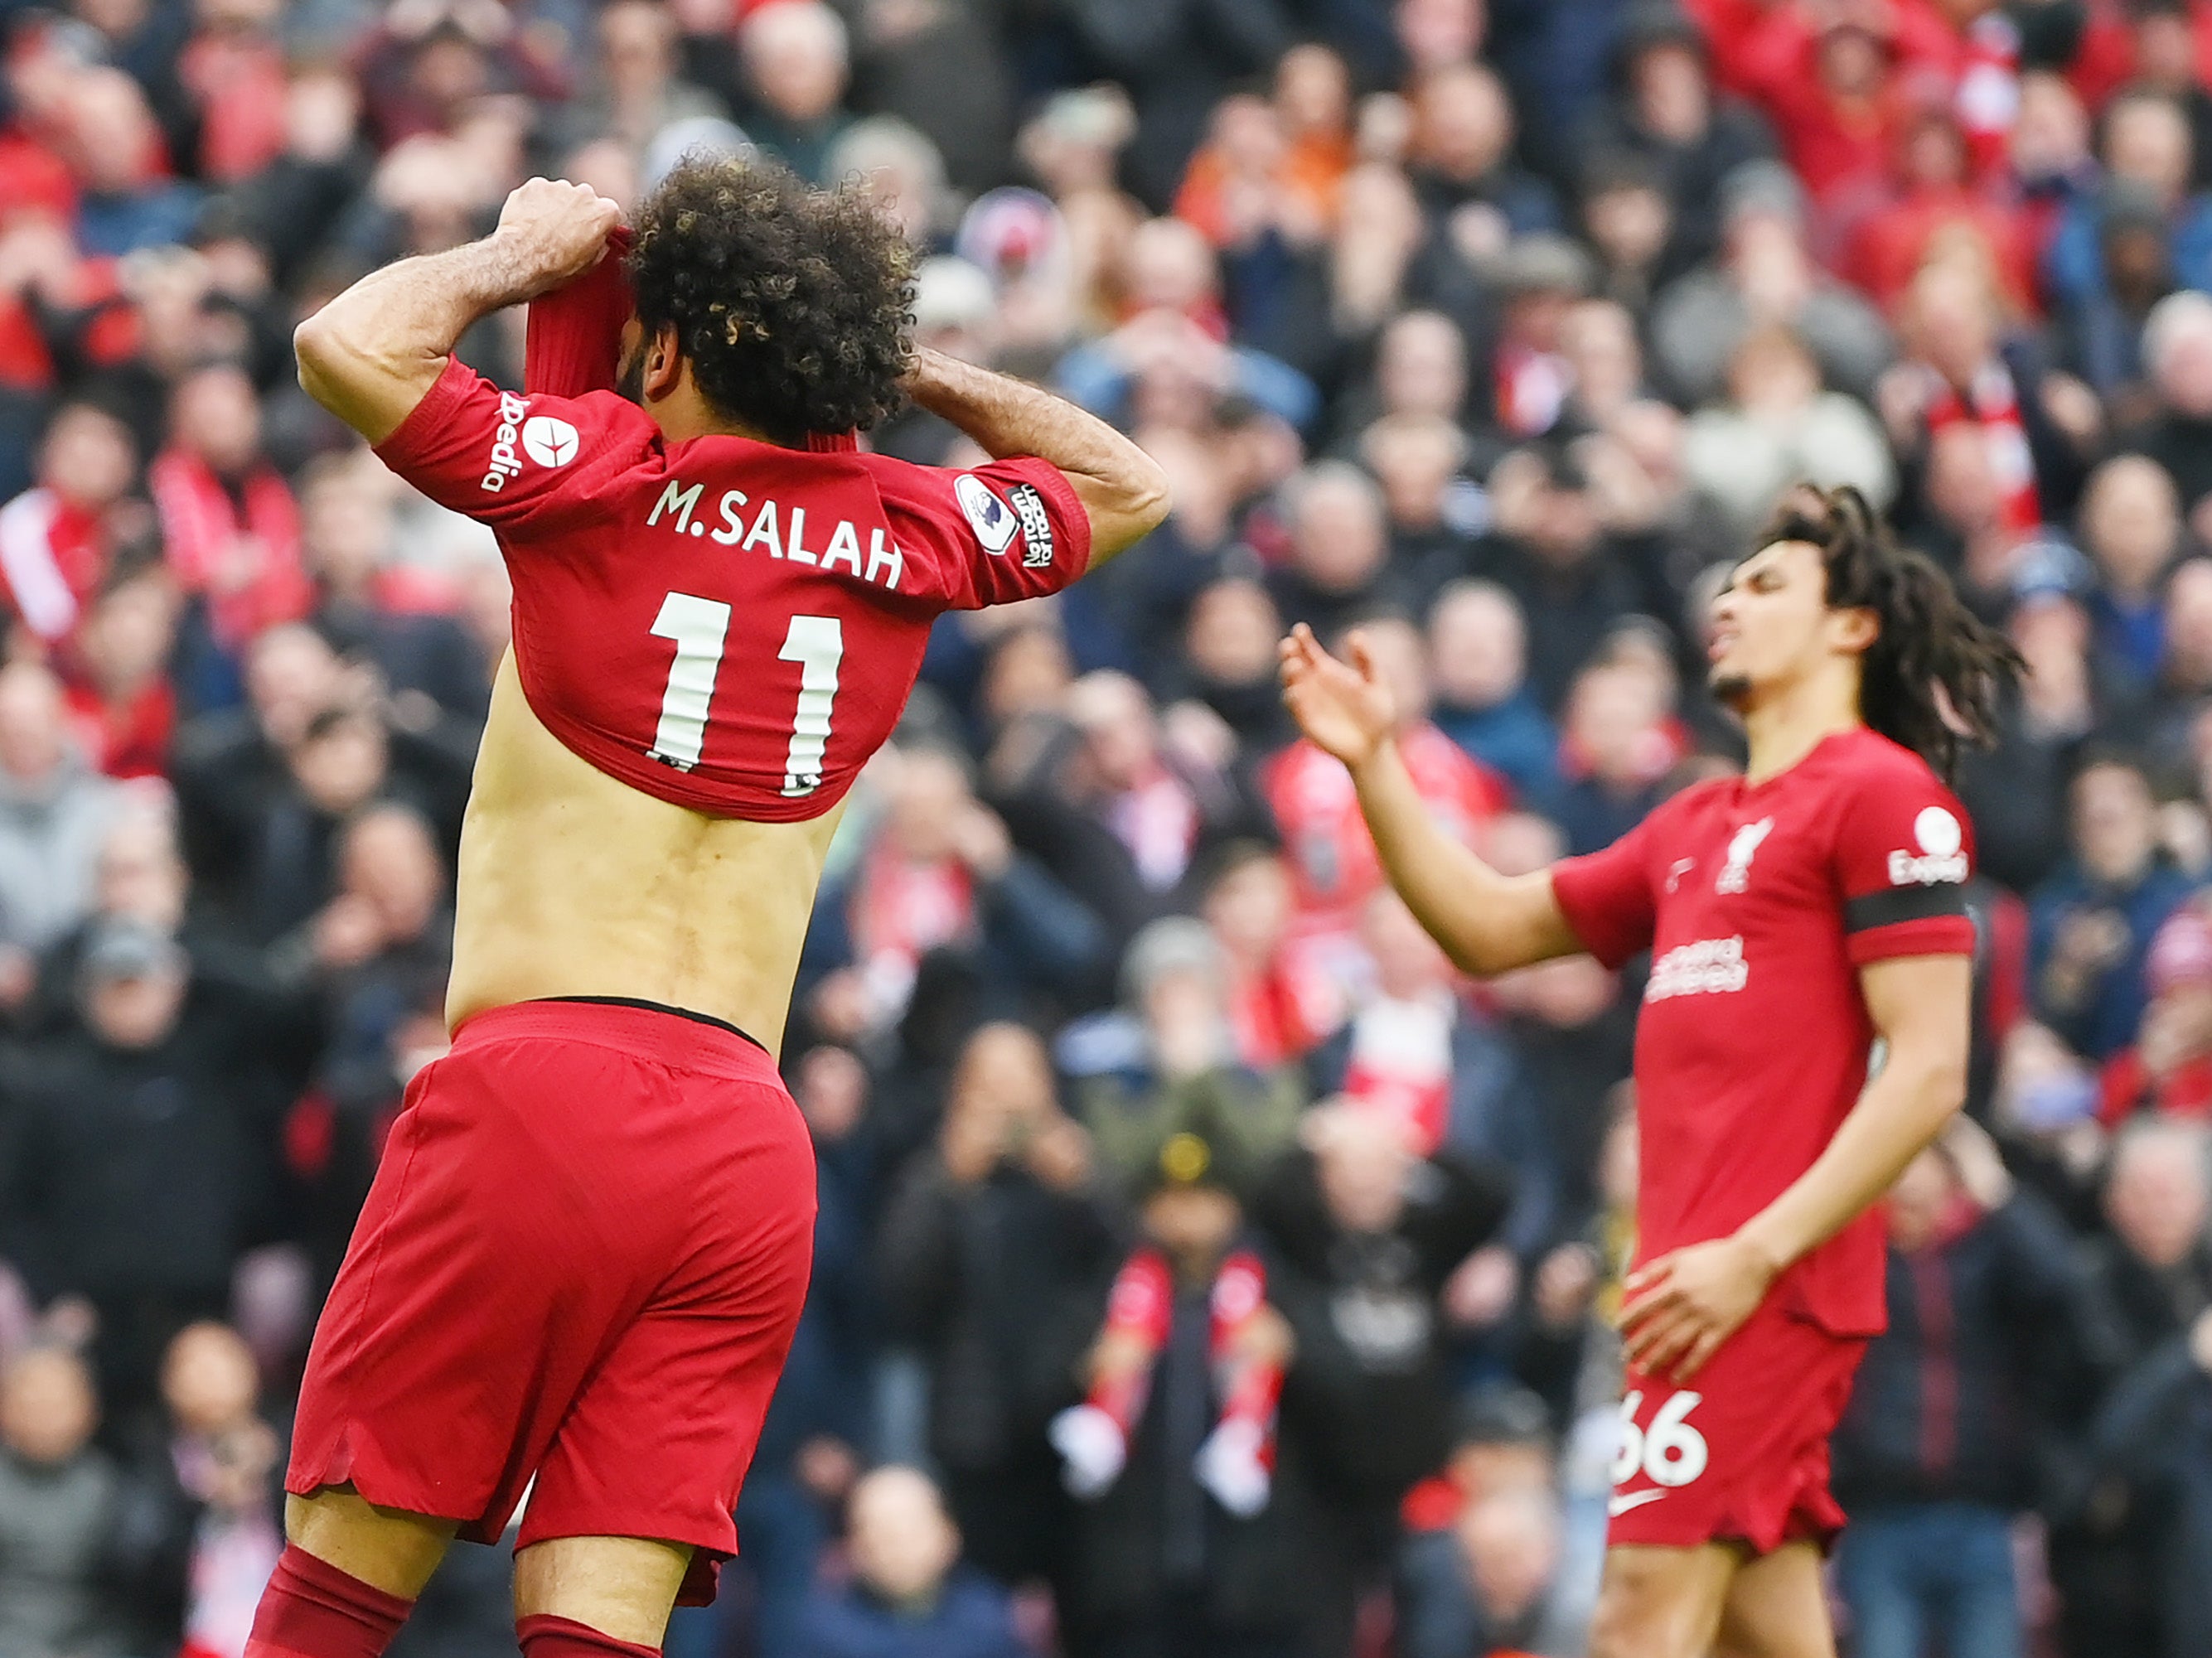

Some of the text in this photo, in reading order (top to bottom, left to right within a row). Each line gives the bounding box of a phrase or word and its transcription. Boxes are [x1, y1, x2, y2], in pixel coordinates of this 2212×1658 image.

[646, 479, 903, 590] M.SALAH
[1010, 491, 1042, 568] No room
[646, 591, 843, 797] 11
